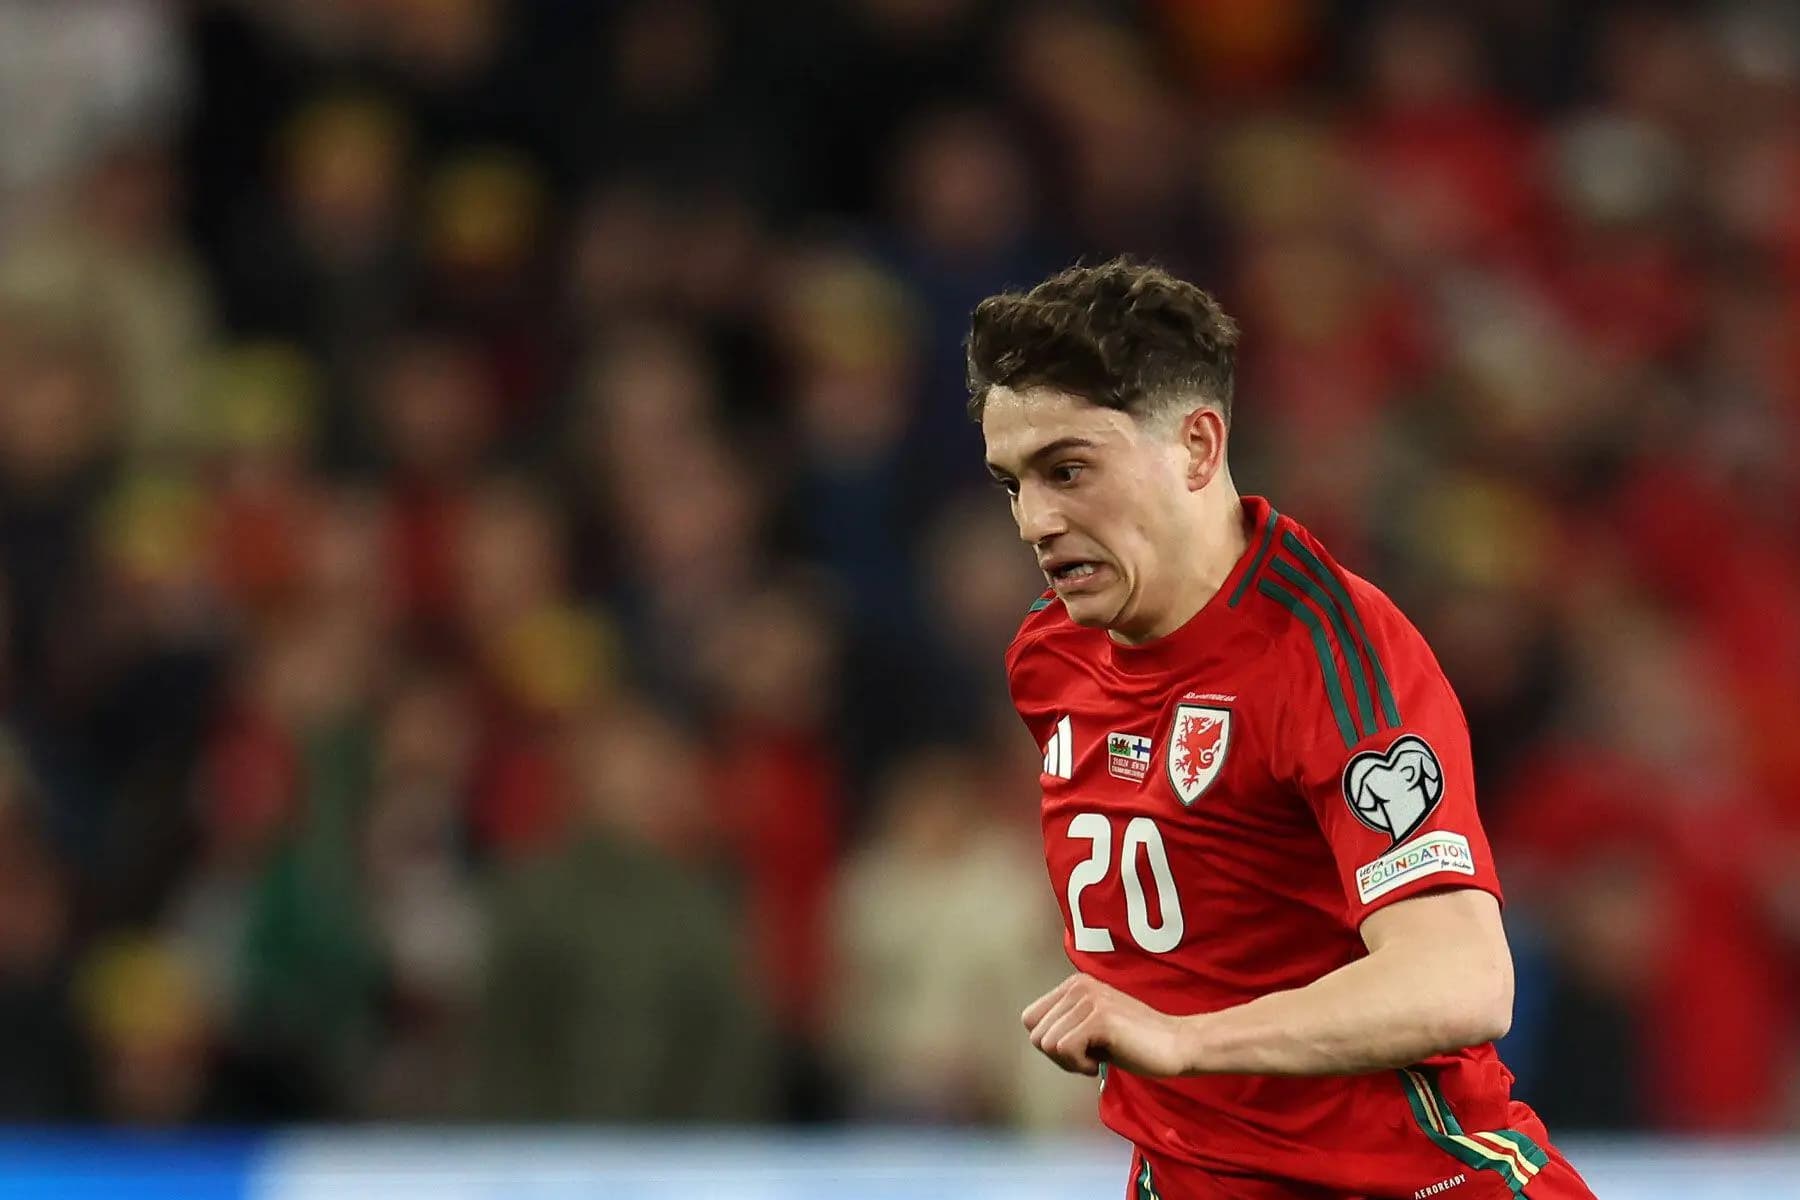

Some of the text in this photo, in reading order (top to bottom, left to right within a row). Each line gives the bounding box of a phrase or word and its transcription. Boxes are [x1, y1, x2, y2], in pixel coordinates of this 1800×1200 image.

[1067, 813, 1185, 954] 20
[1359, 860, 1384, 879] UEFA
[1360, 844, 1469, 891] FOUNDATION
[1414, 1173, 1466, 1200] AEROREADY
